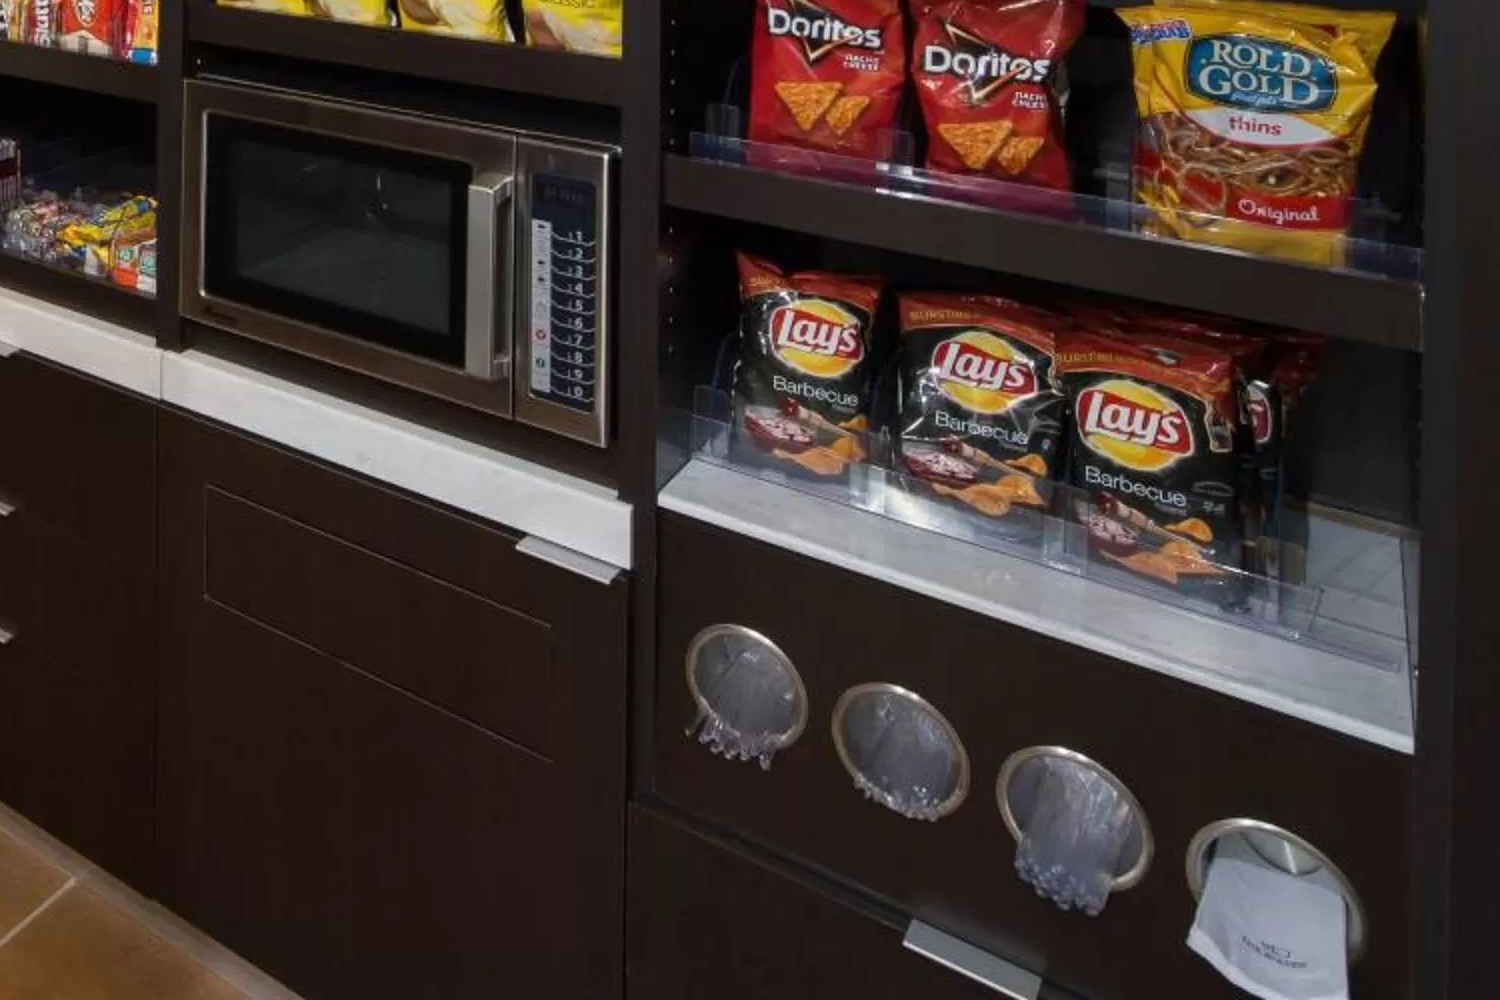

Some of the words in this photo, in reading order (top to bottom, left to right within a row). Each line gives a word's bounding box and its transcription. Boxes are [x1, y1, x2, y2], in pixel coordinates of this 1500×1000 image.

[767, 7, 882, 48] Doritos
[924, 45, 1051, 82] Doritos
[1210, 40, 1312, 77] ROLD
[1199, 65, 1320, 106] GOLD
[1229, 116, 1283, 136] thins
[1237, 198, 1321, 227] Original
[772, 374, 860, 408] Barbecue
[934, 409, 1031, 446] Barbecue
[1084, 464, 1188, 508] Barbecue
